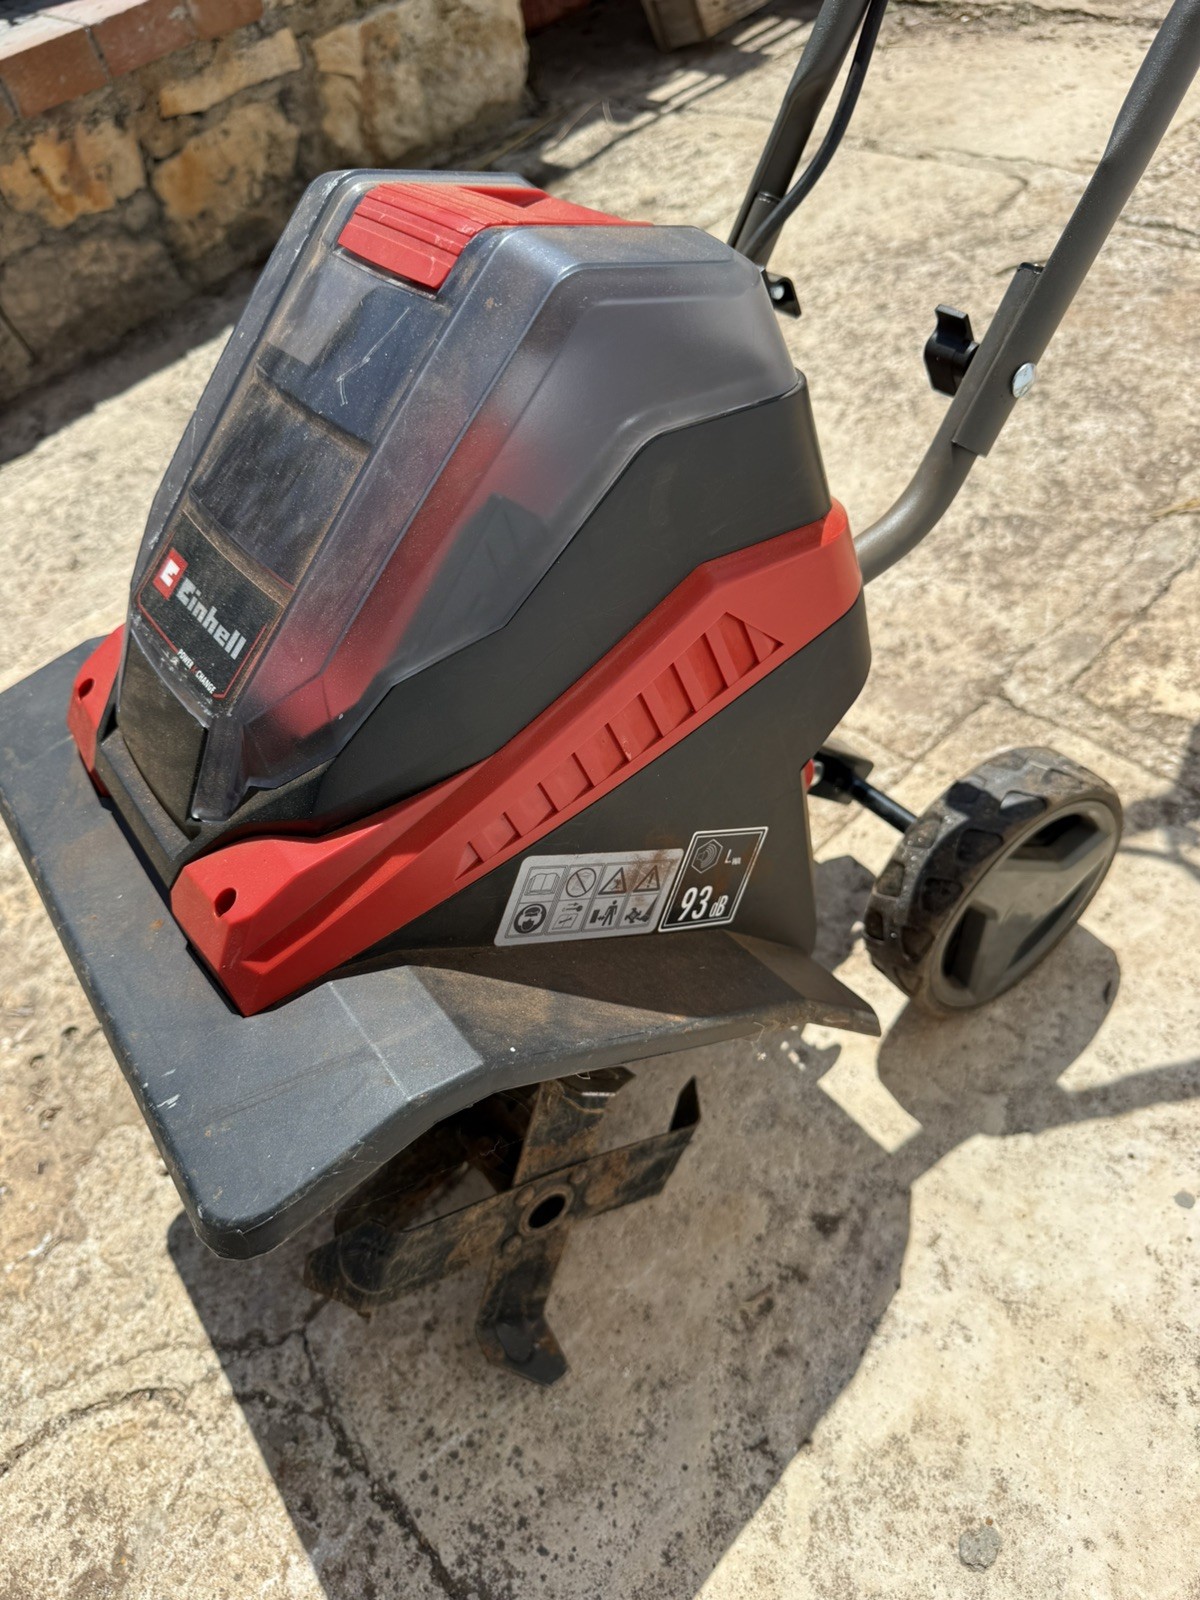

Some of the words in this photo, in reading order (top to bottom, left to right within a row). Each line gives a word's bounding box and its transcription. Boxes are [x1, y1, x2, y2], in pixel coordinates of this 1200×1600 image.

[176, 577, 247, 660] Einhell
[177, 648, 194, 670] POWER
[677, 885, 713, 921] 93
[709, 895, 729, 918] dB
